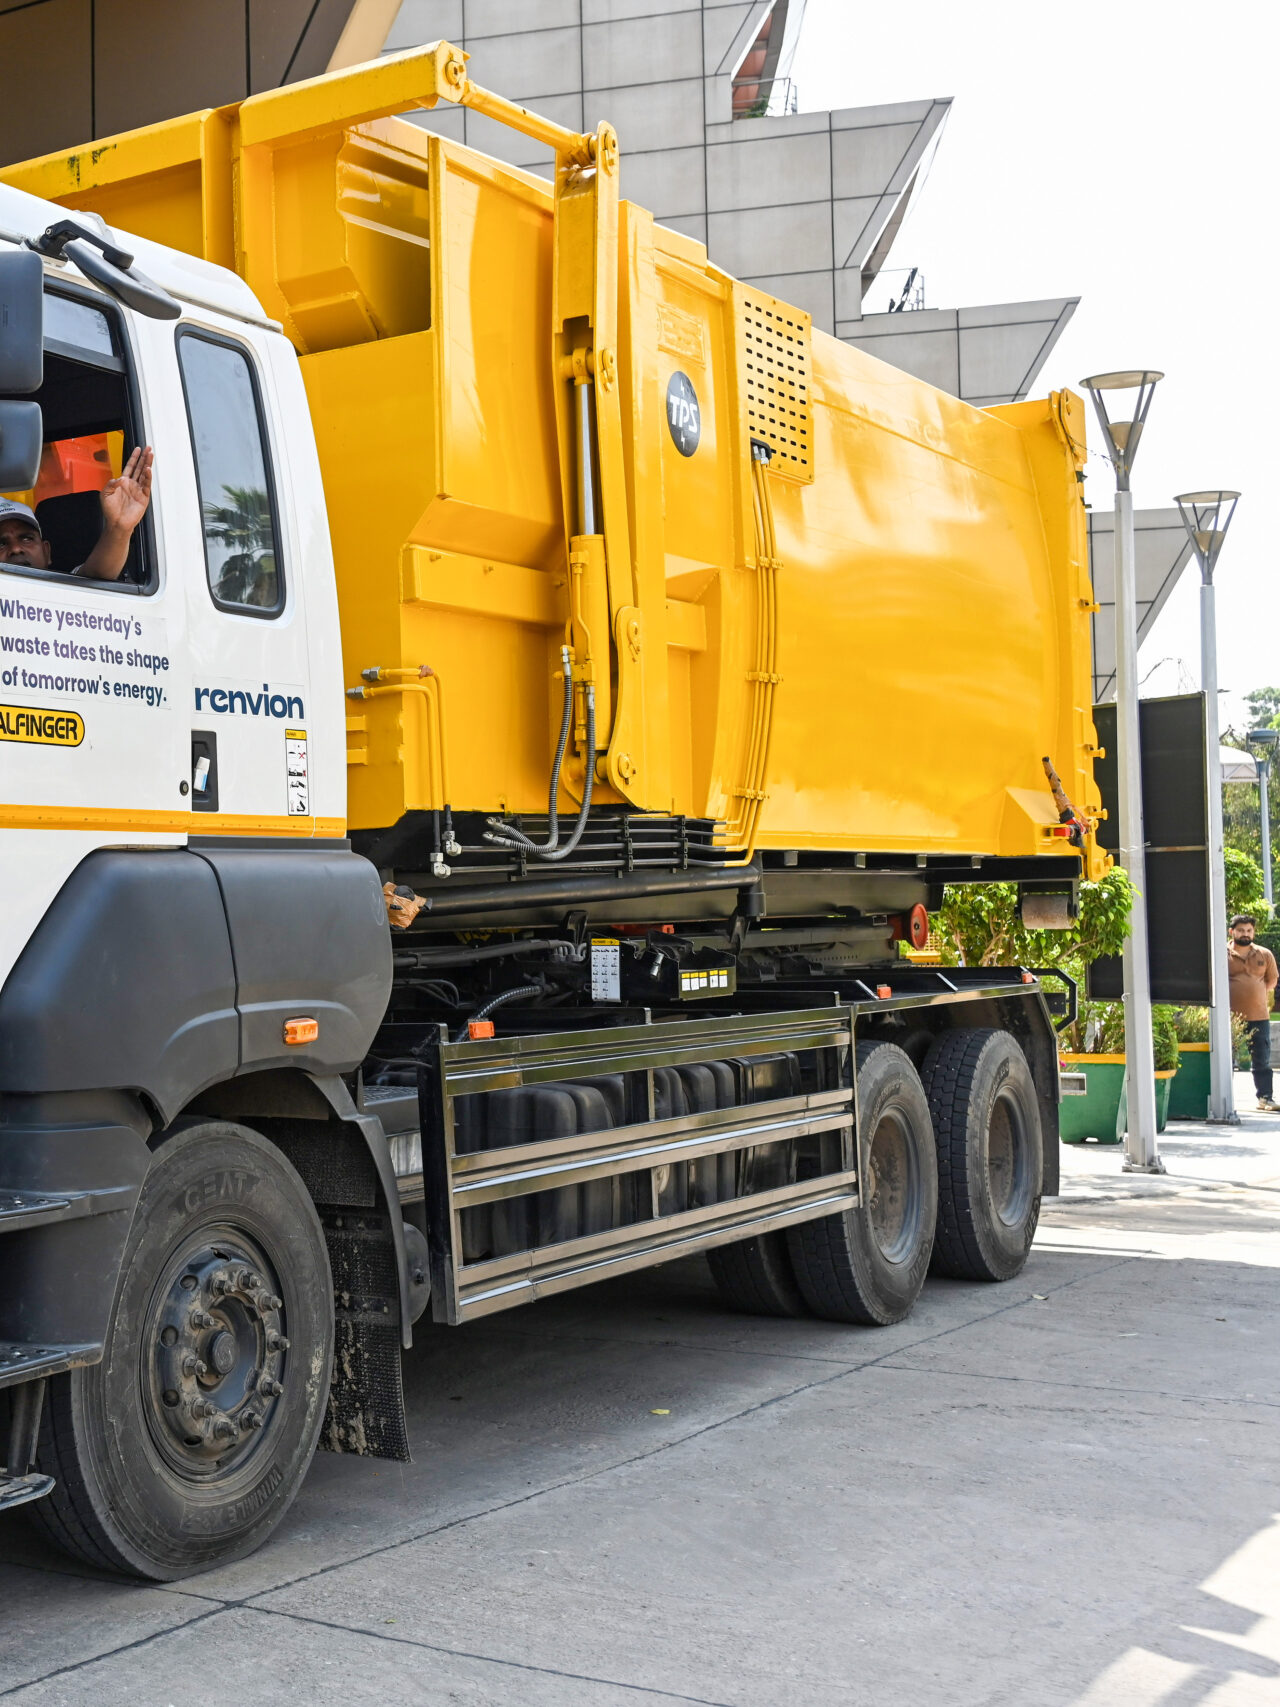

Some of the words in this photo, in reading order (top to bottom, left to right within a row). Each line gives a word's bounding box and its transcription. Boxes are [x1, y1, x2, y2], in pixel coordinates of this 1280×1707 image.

[670, 394, 698, 434] TPS
[55, 609, 142, 640] yesterday's
[0, 636, 50, 656] waste
[53, 639, 96, 662] takes
[99, 645, 123, 665] the
[126, 649, 170, 675] shape
[2, 666, 18, 686] of
[22, 668, 110, 696] tomorrow's
[113, 681, 167, 707] energy.
[194, 683, 305, 719] renvion
